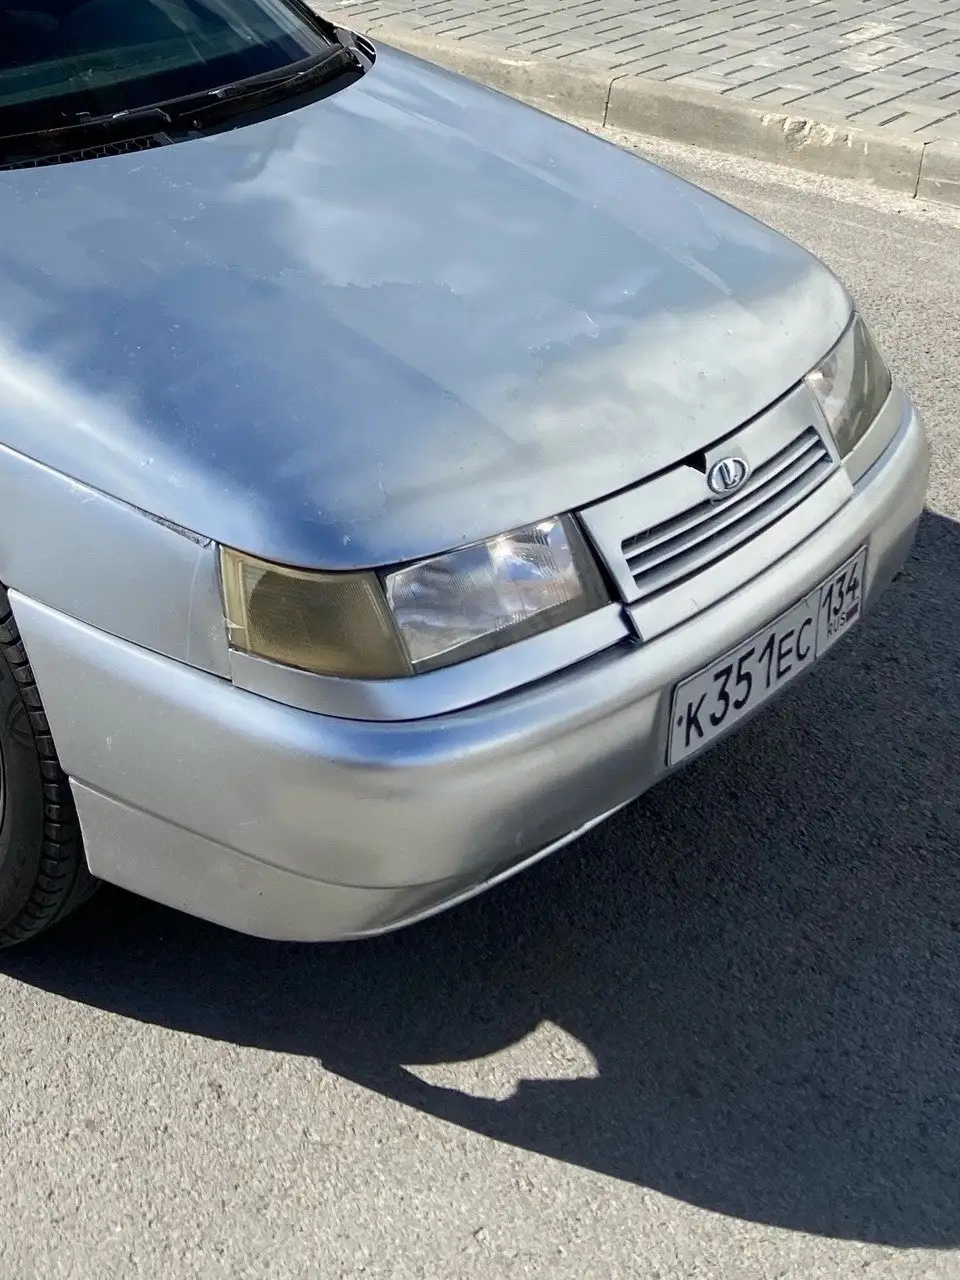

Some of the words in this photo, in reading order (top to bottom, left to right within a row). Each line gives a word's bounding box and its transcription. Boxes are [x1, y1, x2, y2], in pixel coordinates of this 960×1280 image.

[685, 617, 813, 748] К351ЕС
[822, 561, 860, 624] 134
[826, 611, 847, 639] RUS
